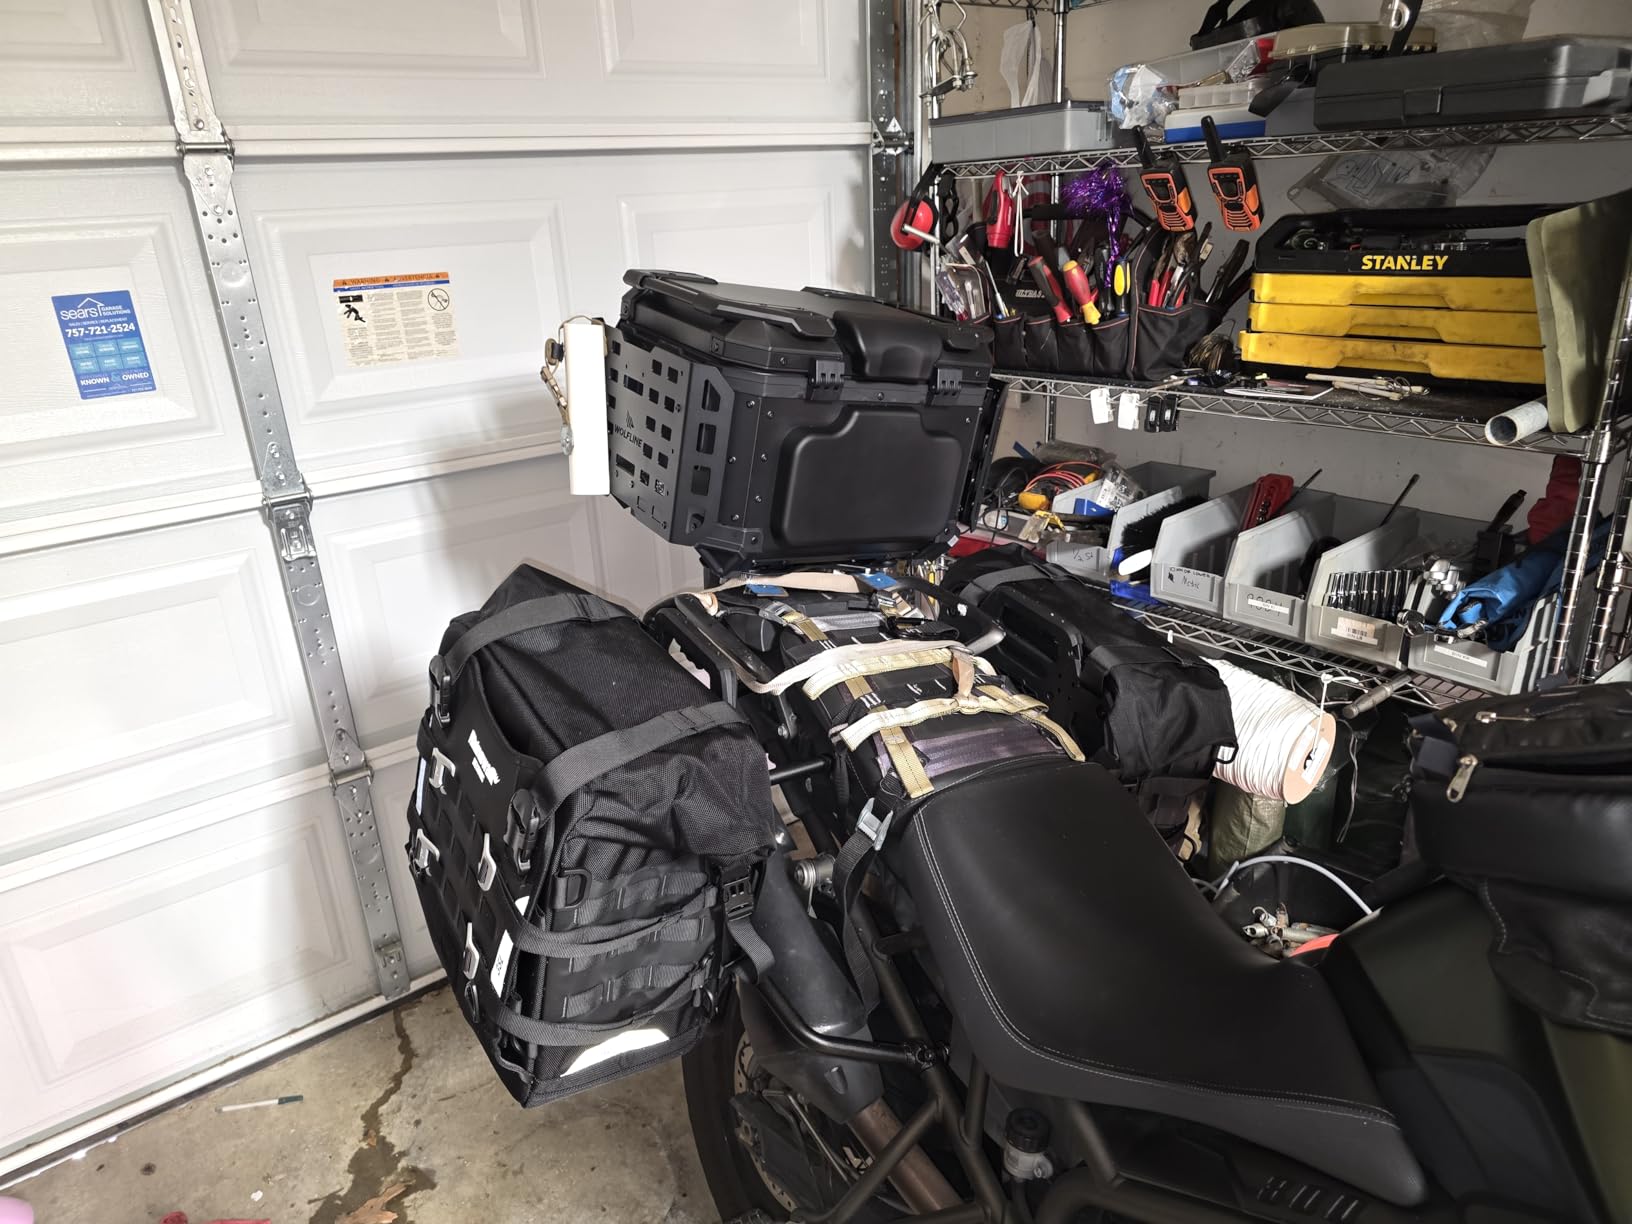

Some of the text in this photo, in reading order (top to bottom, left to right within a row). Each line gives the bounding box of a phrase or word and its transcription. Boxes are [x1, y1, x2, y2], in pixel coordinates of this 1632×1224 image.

[1361, 255, 1449, 270] STANLEY
[60, 307, 99, 320] sears
[65, 323, 135, 338] 757-721-2524
[80, 376, 110, 386] KNOWN
[121, 372, 149, 381] OWNED
[614, 424, 643, 448] WOLFLINE
